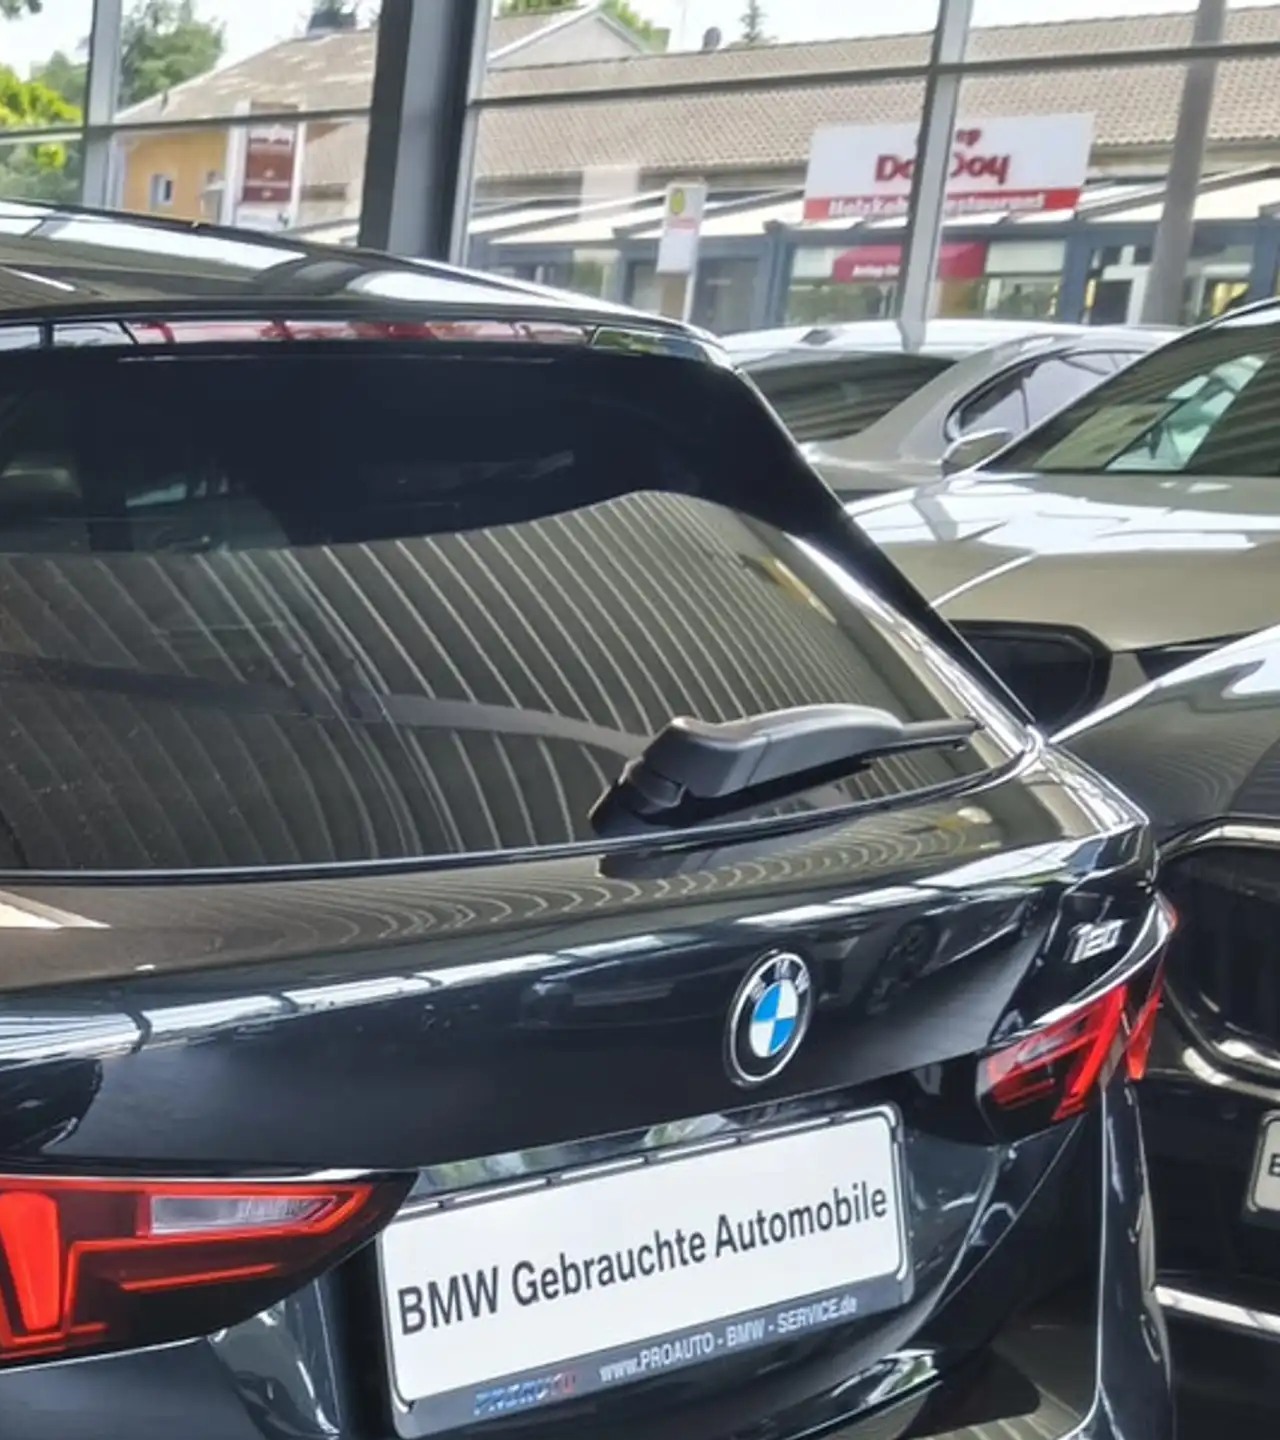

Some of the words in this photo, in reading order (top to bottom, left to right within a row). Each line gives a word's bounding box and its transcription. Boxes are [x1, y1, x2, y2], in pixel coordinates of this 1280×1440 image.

[397, 1266, 499, 1336] BMW
[511, 1229, 706, 1308] Gebrauchte
[714, 1180, 888, 1257] Automobile
